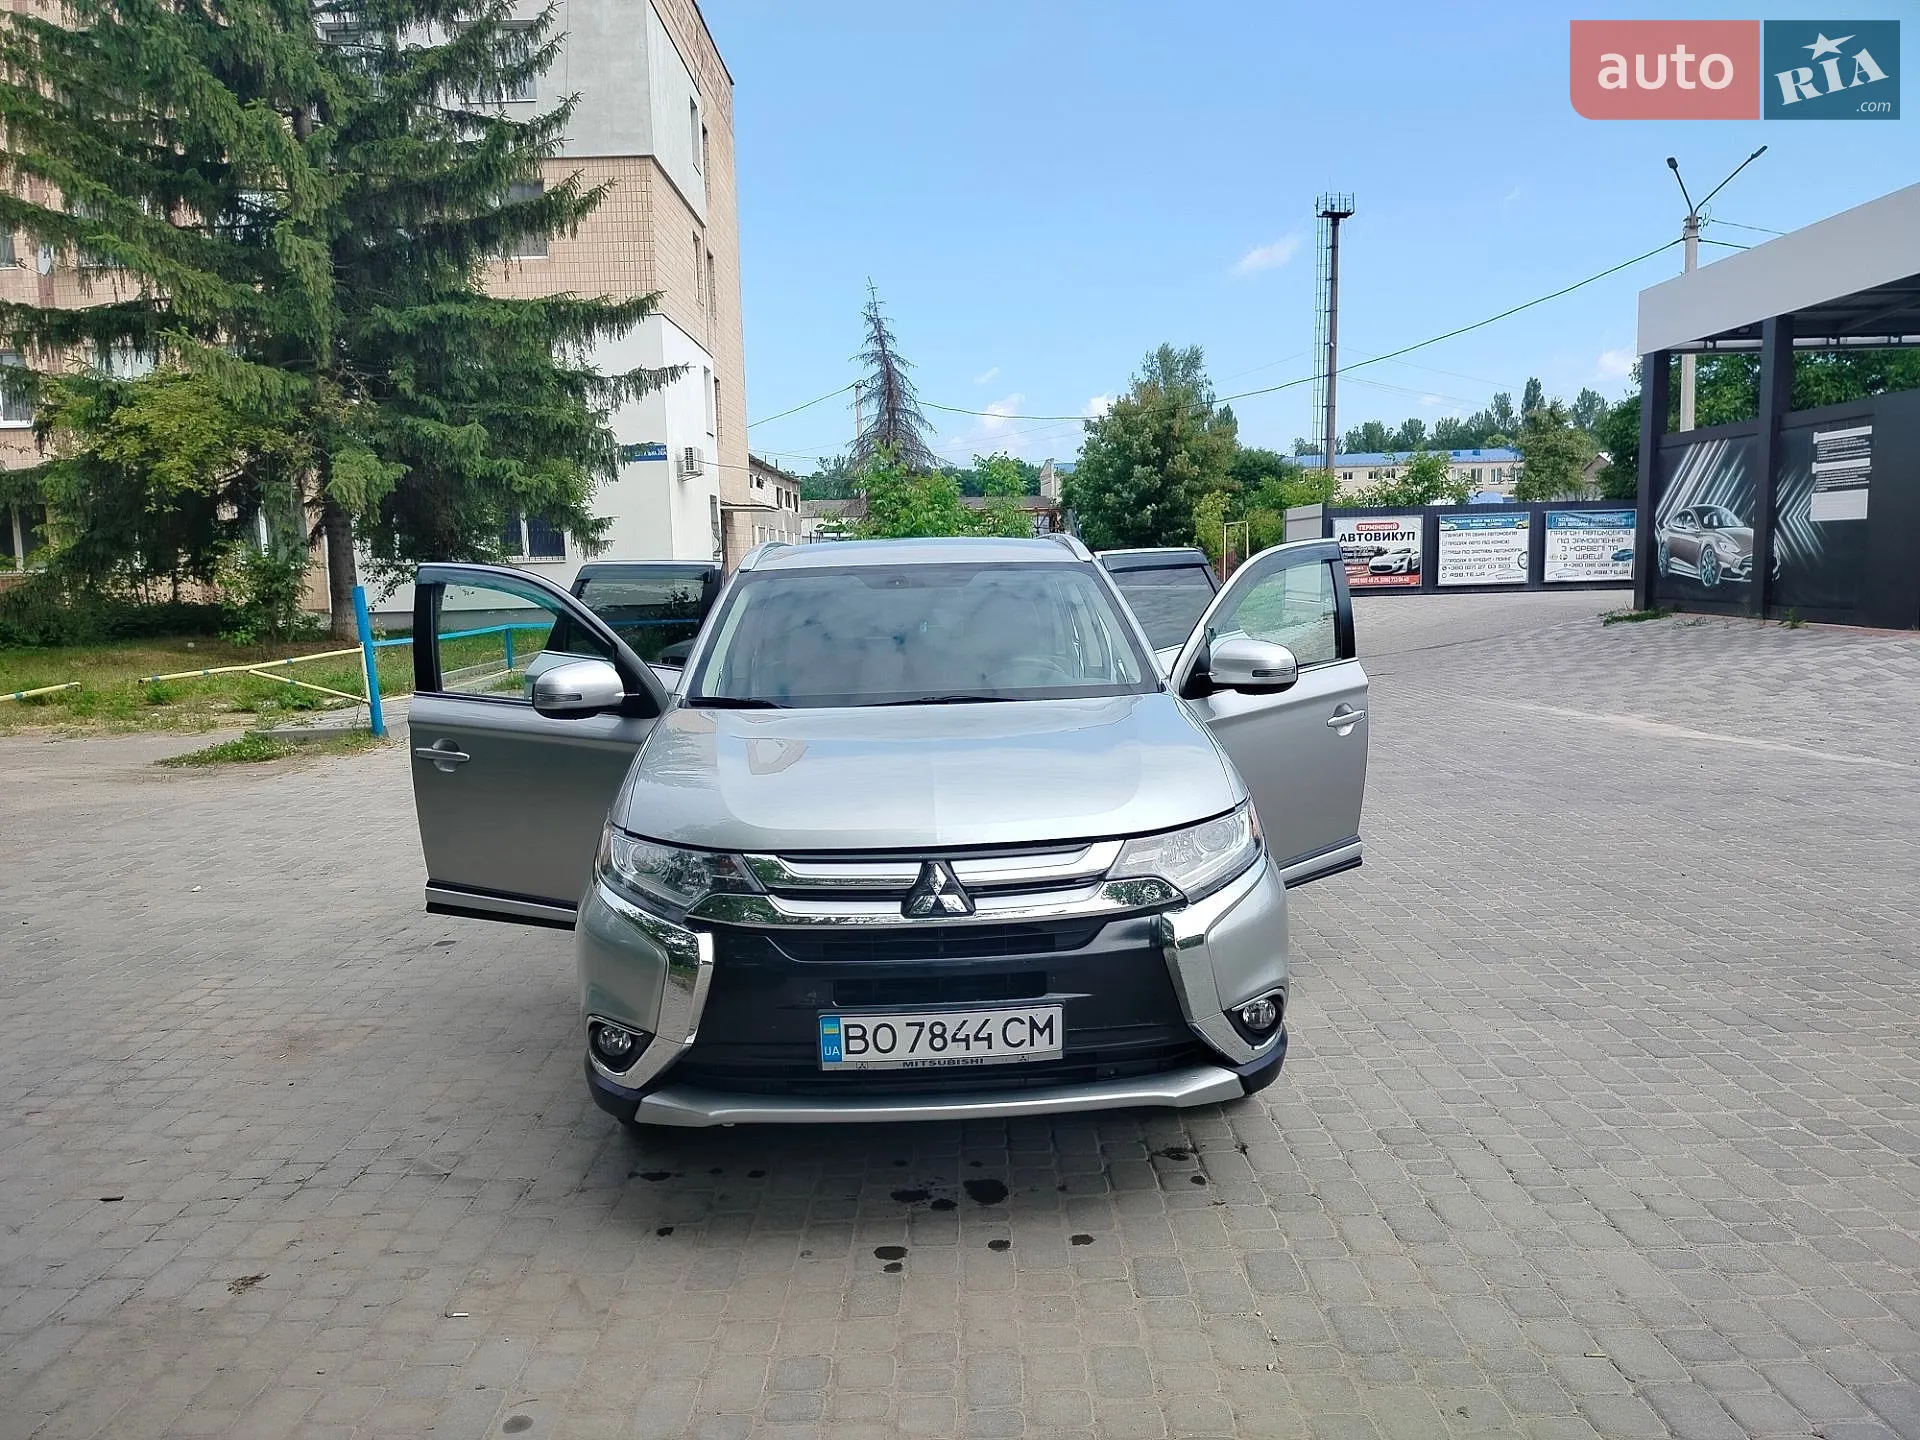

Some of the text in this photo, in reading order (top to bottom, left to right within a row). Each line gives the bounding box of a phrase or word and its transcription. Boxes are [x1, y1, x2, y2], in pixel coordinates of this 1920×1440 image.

[1359, 522, 1397, 531] ТЕРМІНОВИЙ
[1339, 531, 1415, 542] АВТОВИКУП
[824, 1014, 1054, 1056] UA BO 7844 CM
[902, 1058, 984, 1068] MITSUBISHI
